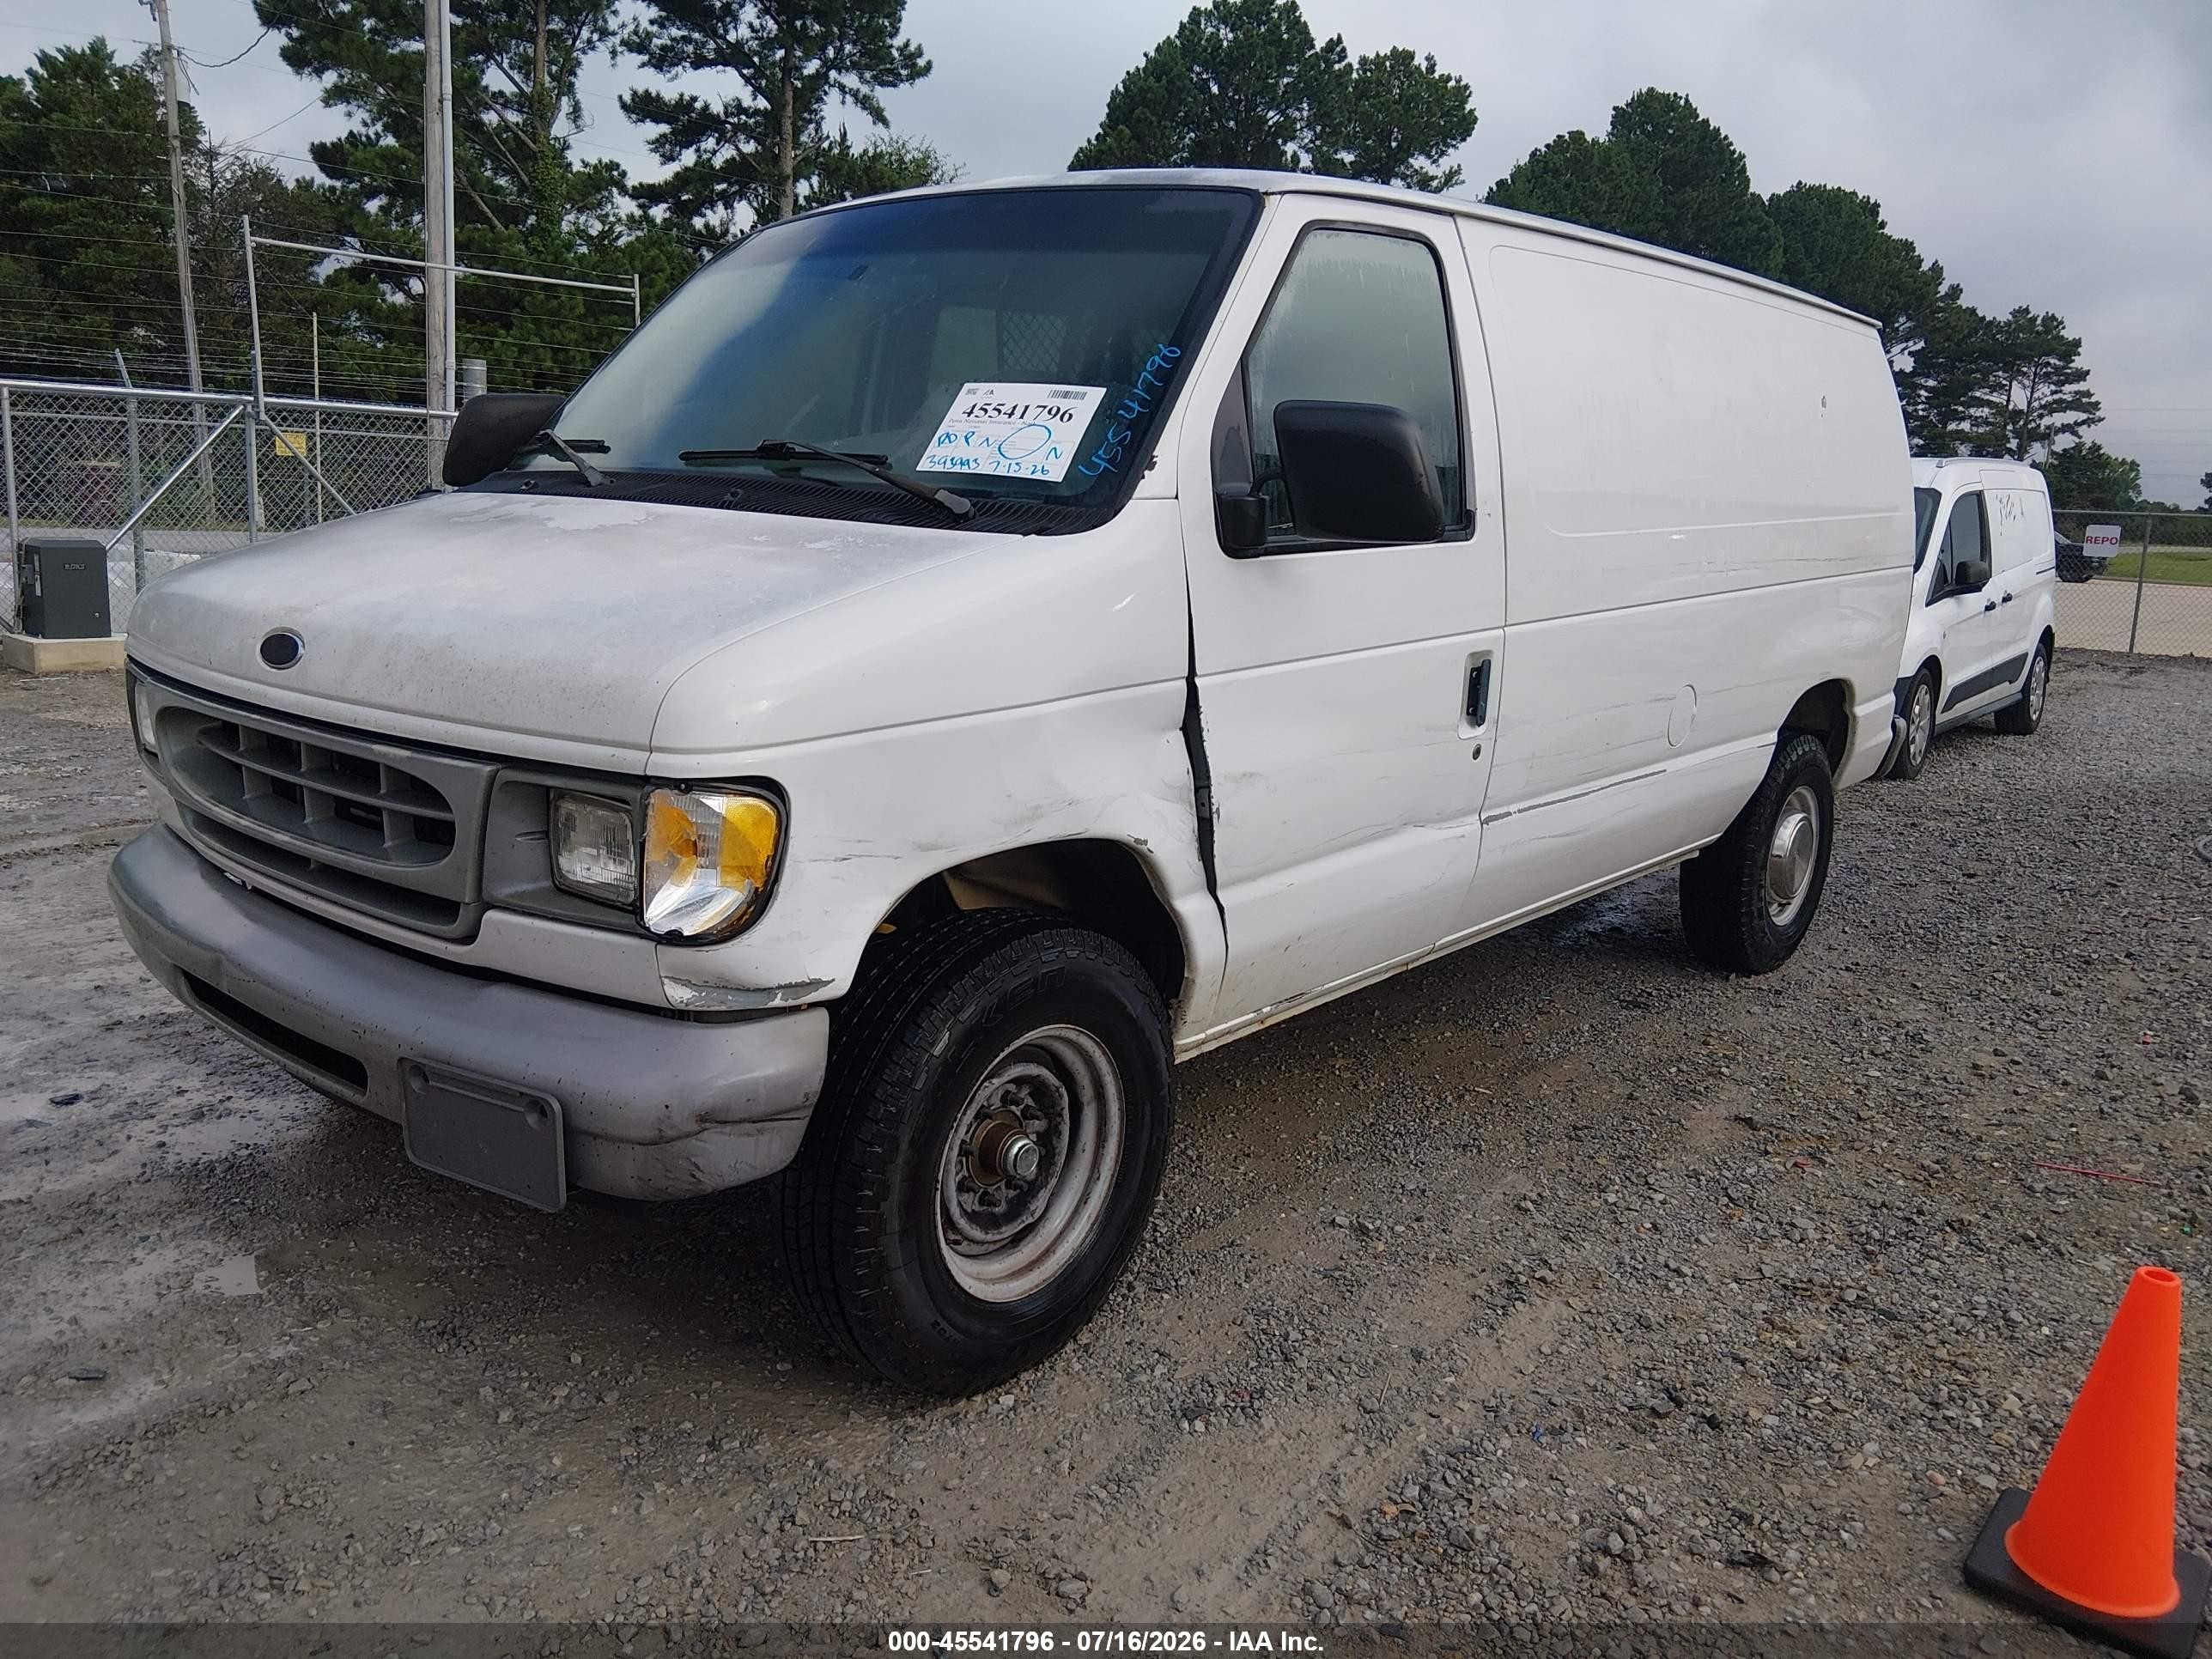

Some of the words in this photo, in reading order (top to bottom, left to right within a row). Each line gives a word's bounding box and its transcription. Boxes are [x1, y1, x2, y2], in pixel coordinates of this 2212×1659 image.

[962, 403, 1078, 423] 45541796
[1079, 343, 1182, 476] 45541796
[2086, 536, 2118, 545] REPO
